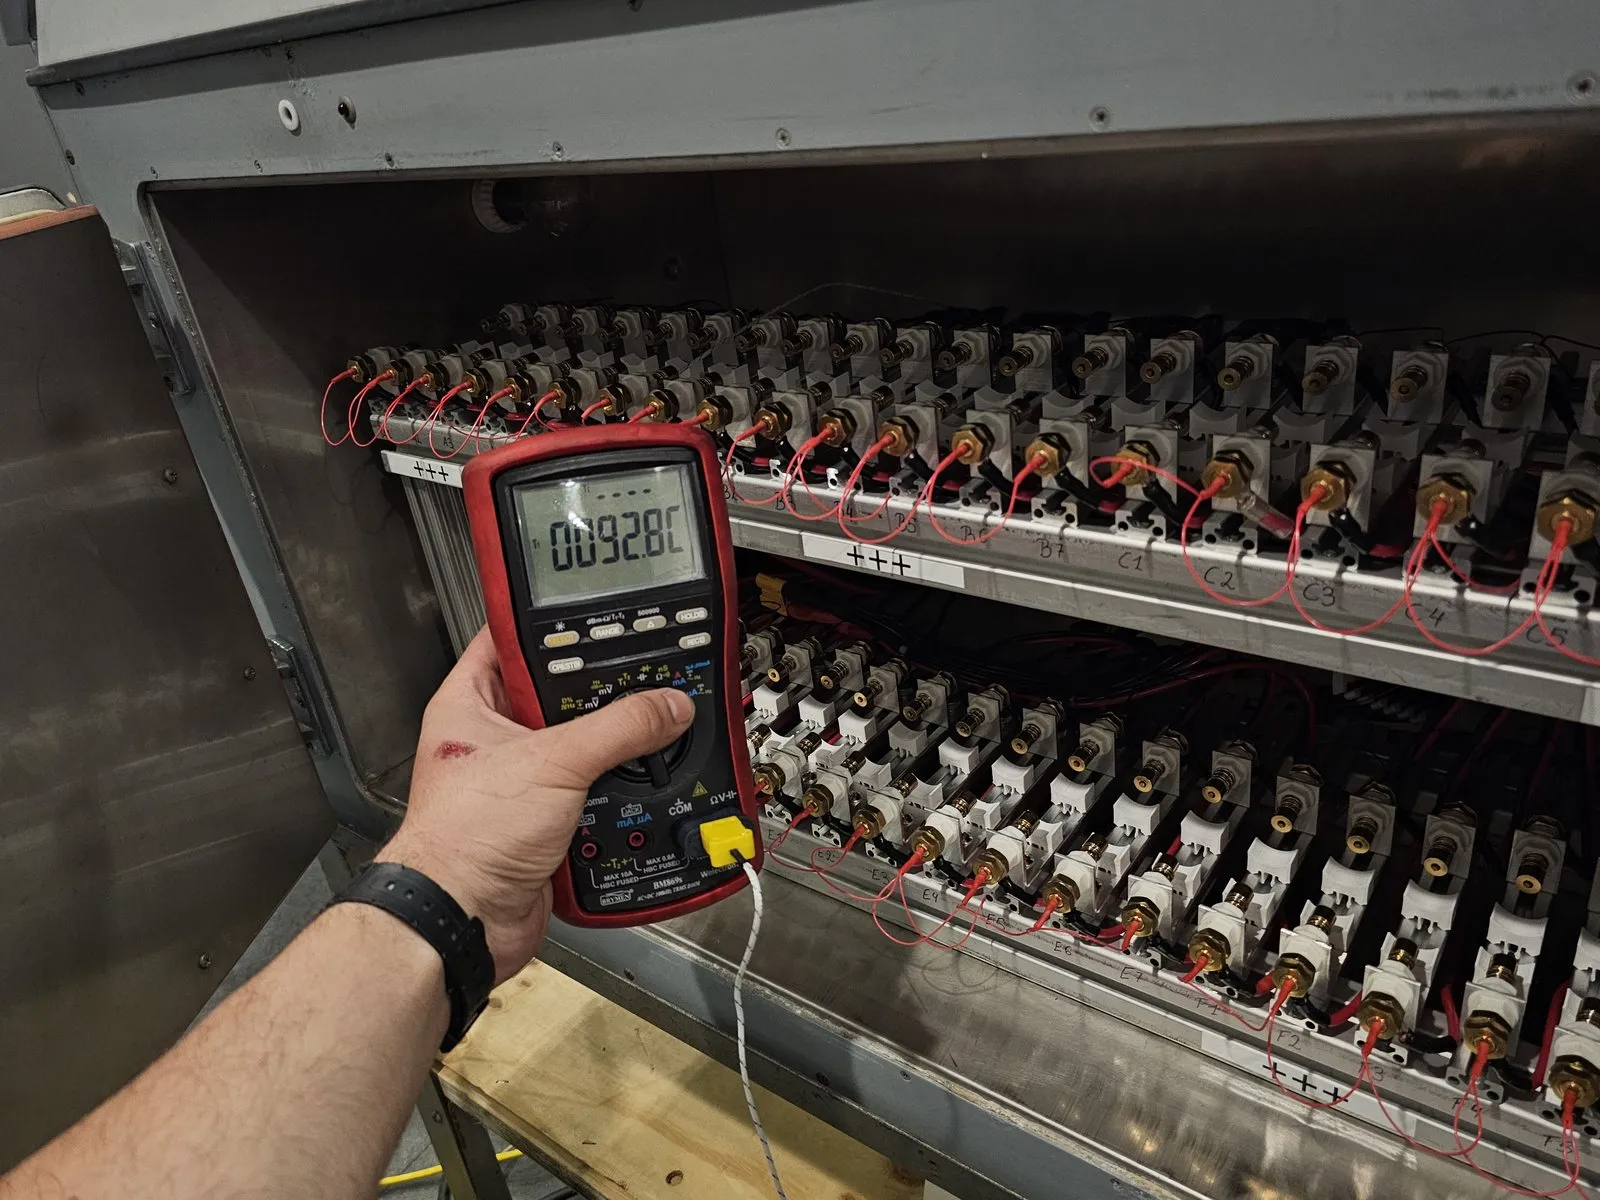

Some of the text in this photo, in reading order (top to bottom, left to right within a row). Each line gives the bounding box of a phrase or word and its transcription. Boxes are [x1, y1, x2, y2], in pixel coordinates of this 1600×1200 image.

[1036, 538, 1065, 558] B7
[1118, 552, 1143, 571] C1
[1203, 566, 1235, 590] C2
[1303, 583, 1336, 607] C3
[668, 802, 693, 816] COM
[616, 816, 635, 828] mA
[923, 888, 939, 903] E4
[1276, 1030, 1301, 1050] F2
